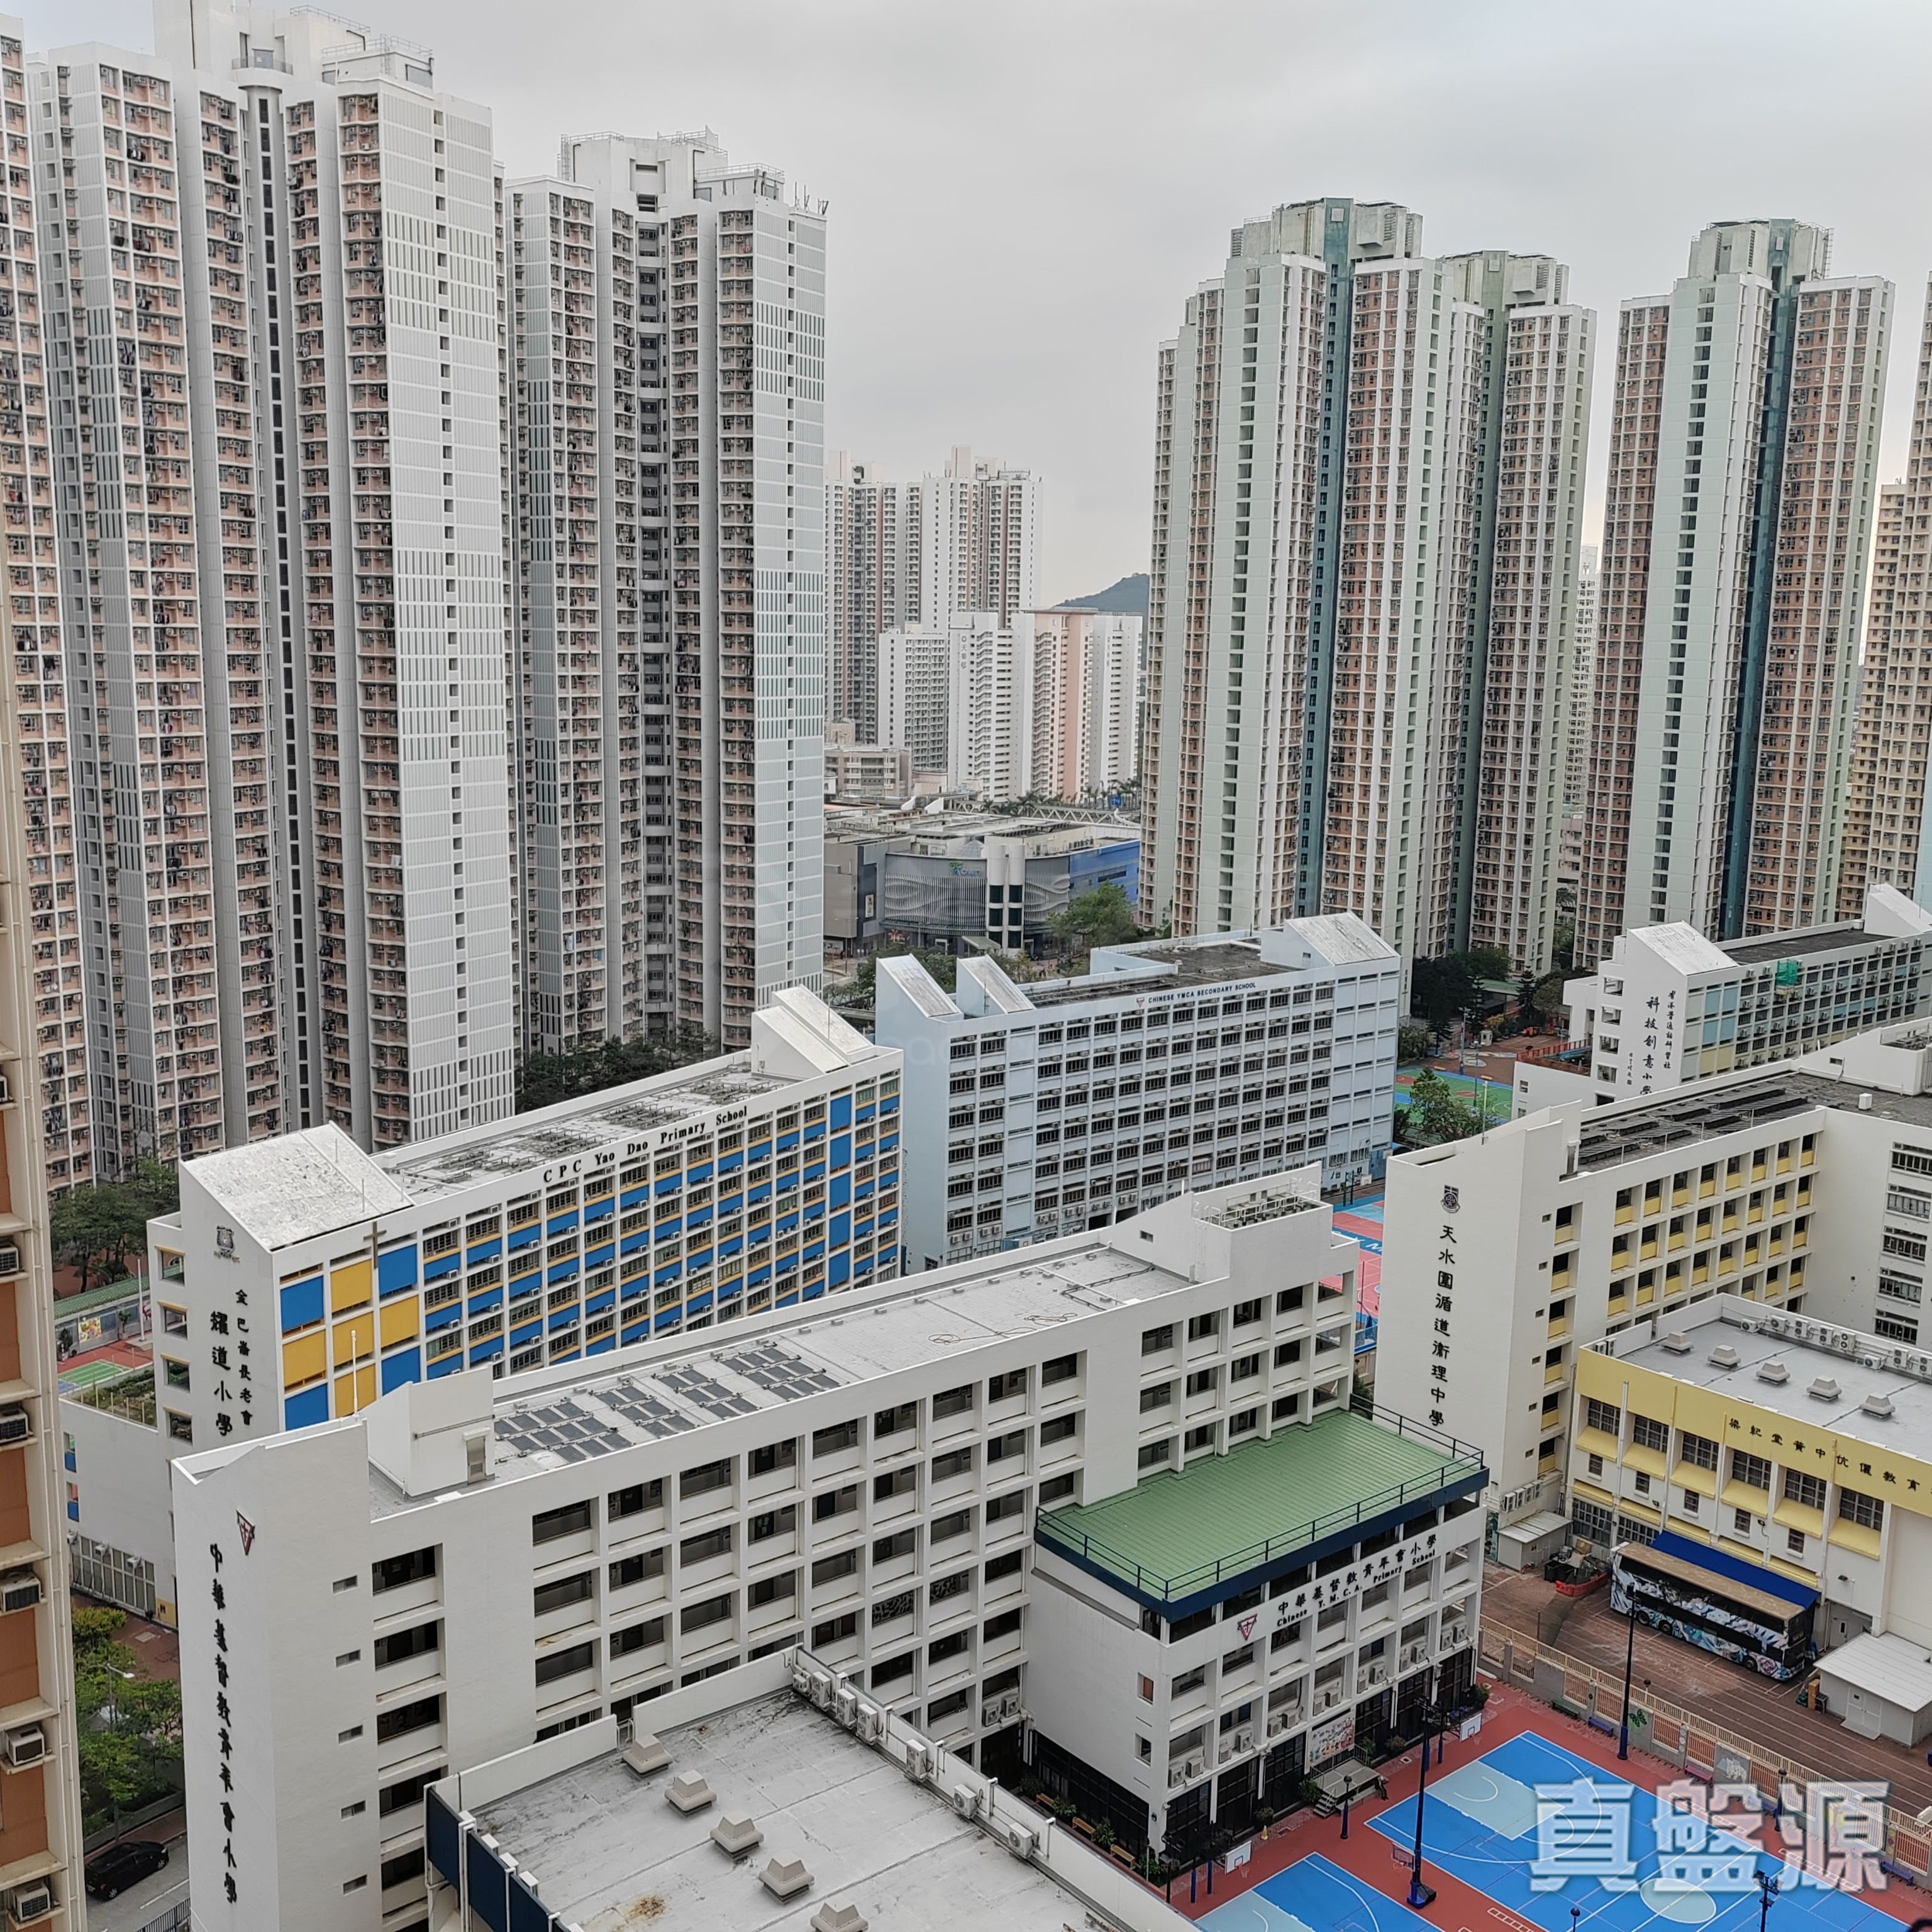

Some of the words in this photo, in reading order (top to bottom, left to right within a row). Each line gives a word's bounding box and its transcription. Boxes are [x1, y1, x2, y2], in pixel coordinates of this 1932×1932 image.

[1148, 994, 1174, 1004] CHINESE
[1177, 991, 1194, 999] YMCA
[1197, 985, 1233, 996] SECONDARY
[1235, 982, 1256, 991] SCHOOL
[594, 1152, 615, 1166] Yao
[626, 1141, 648, 1155] Dao
[660, 1122, 706, 1144] Primary
[716, 1106, 747, 1126] School
[1729, 1417, 1932, 1492] 梁紀堂黃中伉儷教育
[1277, 1609, 1308, 1627] Chinese
[1373, 1565, 1403, 1584] Primary
[1412, 1549, 1435, 1565] School
[1278, 1533, 1437, 1615] 中華基督教青年會小學
